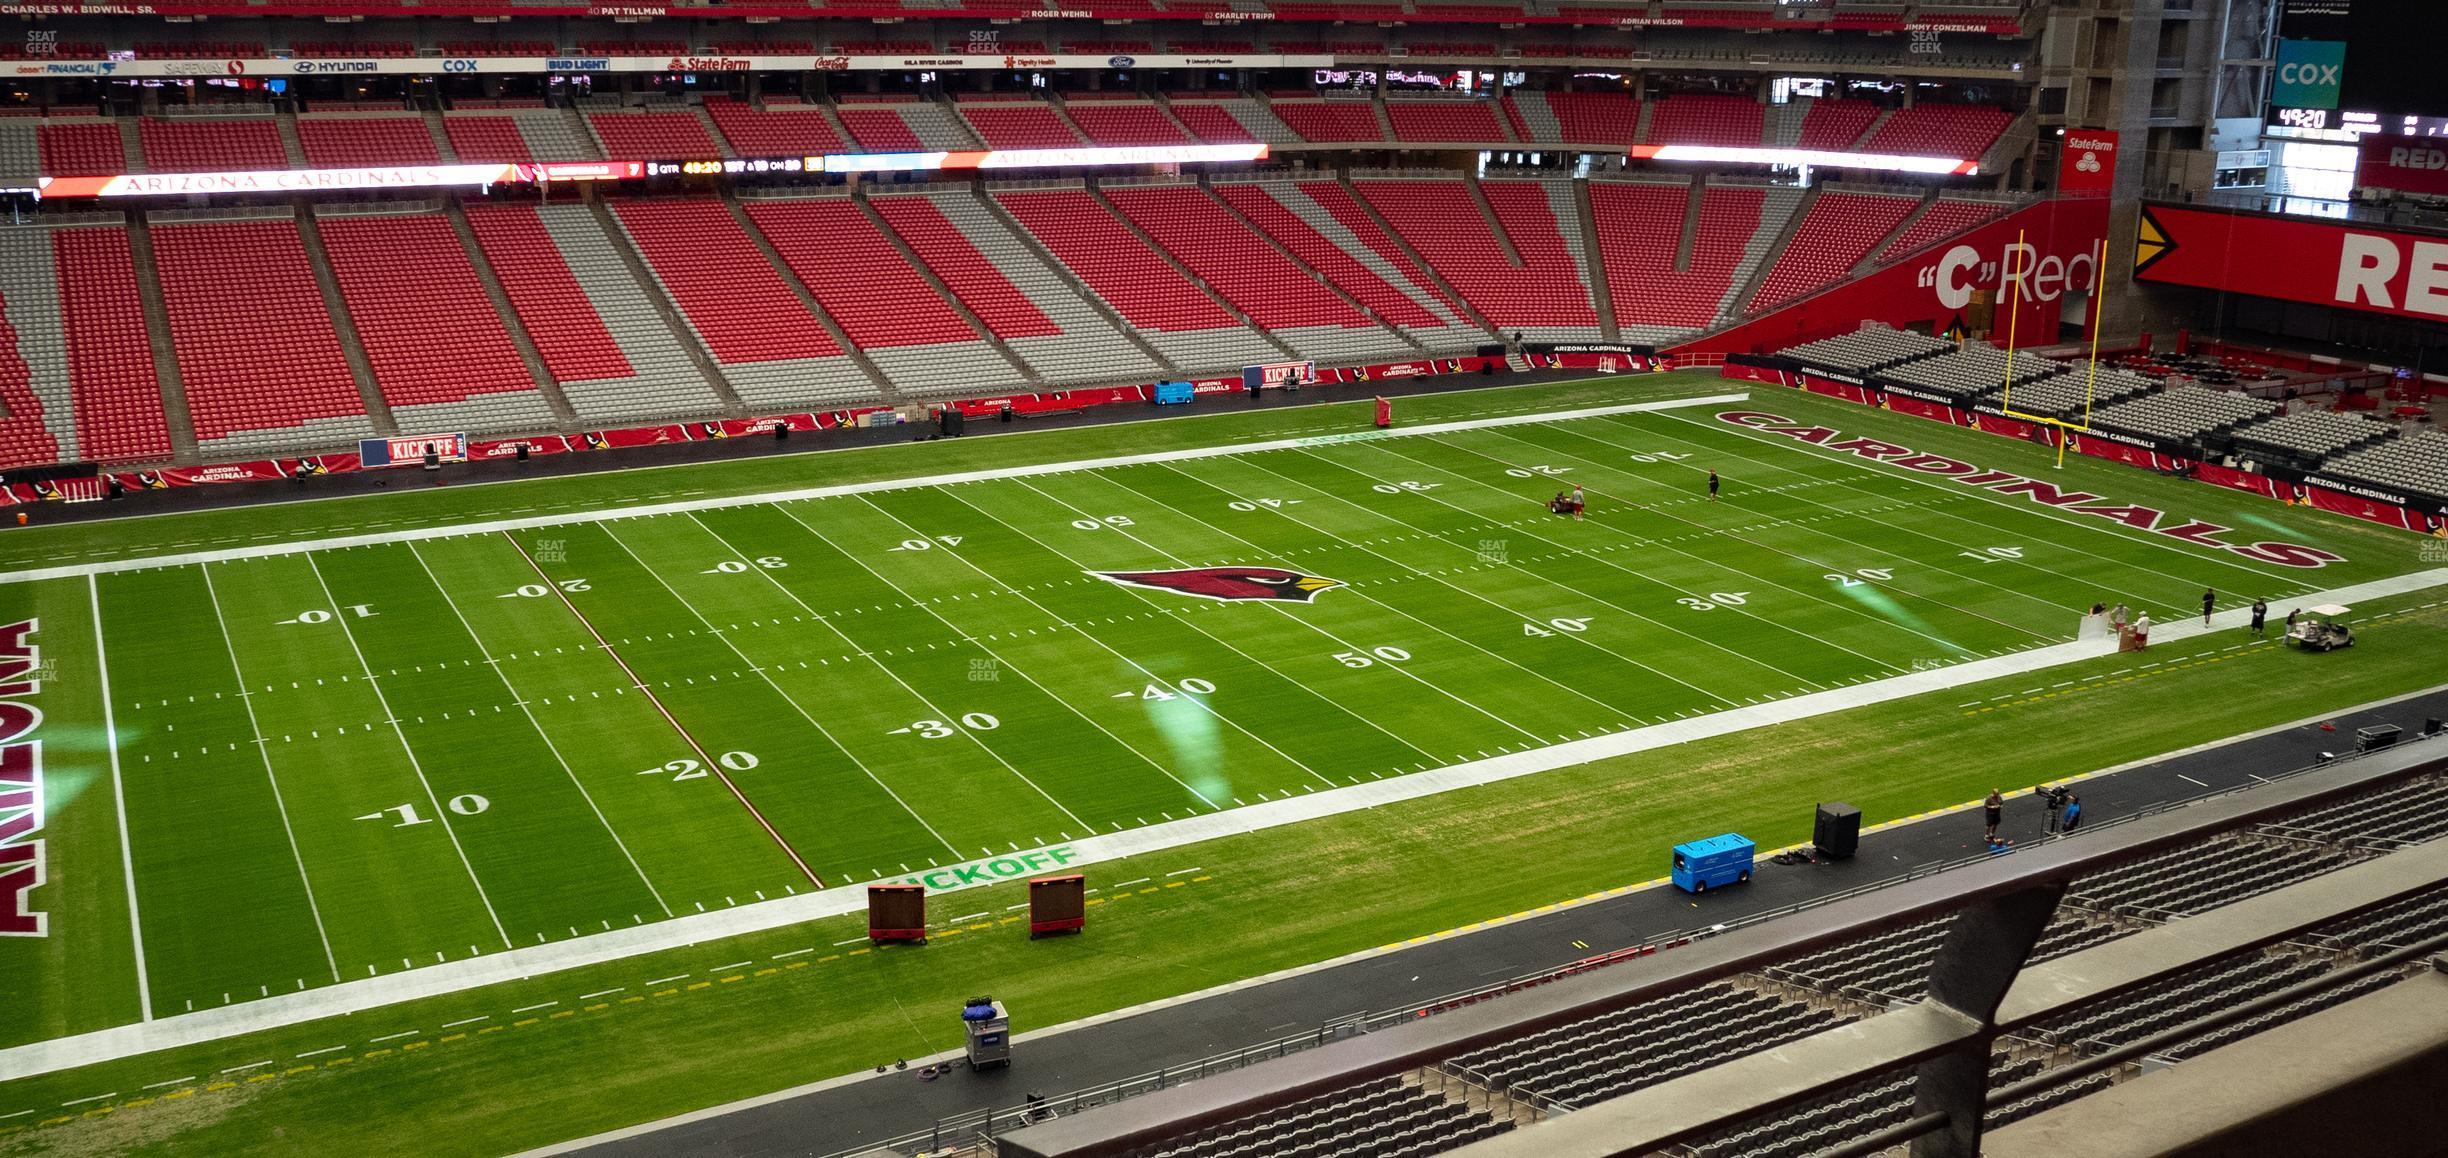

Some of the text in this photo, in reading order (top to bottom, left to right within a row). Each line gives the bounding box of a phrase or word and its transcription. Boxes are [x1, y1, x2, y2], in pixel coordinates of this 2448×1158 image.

[1, 5, 156, 14] CHARLES W. BIDWILL, SR.
[601, 7, 620, 15] PAT
[623, 7, 666, 15] TILLMAN
[1031, 10, 1059, 18] ROGER
[1061, 10, 1093, 18] WEHRLI
[1215, 12, 1249, 20] CHARLEY
[1251, 12, 1275, 20] TRIPPI
[46, 64, 95, 74] FINANCIAL
[164, 63, 224, 75] SAFEWAY
[318, 62, 378, 73] HYUNDAI
[443, 60, 478, 72] COX
[549, 60, 608, 71] BUD LIGHT
[1018, 59, 1038, 67] Dignity
[2280, 63, 2339, 86] COX
[2280, 109, 2326, 128] 49:20
[2389, 146, 2448, 171] RED
[660, 165, 679, 174] QTR
[127, 175, 259, 192] ARIZONA
[1589, 345, 1632, 353] CARDINALS
[1801, 366, 1864, 385] ARIZONA CARDINALS
[1193, 384, 1230, 393] ARDINALS
[1883, 385, 1953, 404] ARIZONA CARDINALS
[746, 422, 795, 433] CARDIS
[2109, 433, 2156, 449] CARDINALS
[487, 445, 543, 456] CARDILS
[191, 470, 253, 483] CARDINALS
[203, 466, 240, 475] ARIZONA
[1715, 409, 2350, 569] CARDINALS
[2303, 476, 2406, 505] ARIZONA CARDINALS
[1142, 678, 1217, 702] 40
[912, 712, 1000, 739] 30
[665, 751, 760, 782] 20
[384, 794, 490, 828] 10
[888, 846, 1076, 890] CKOFF
